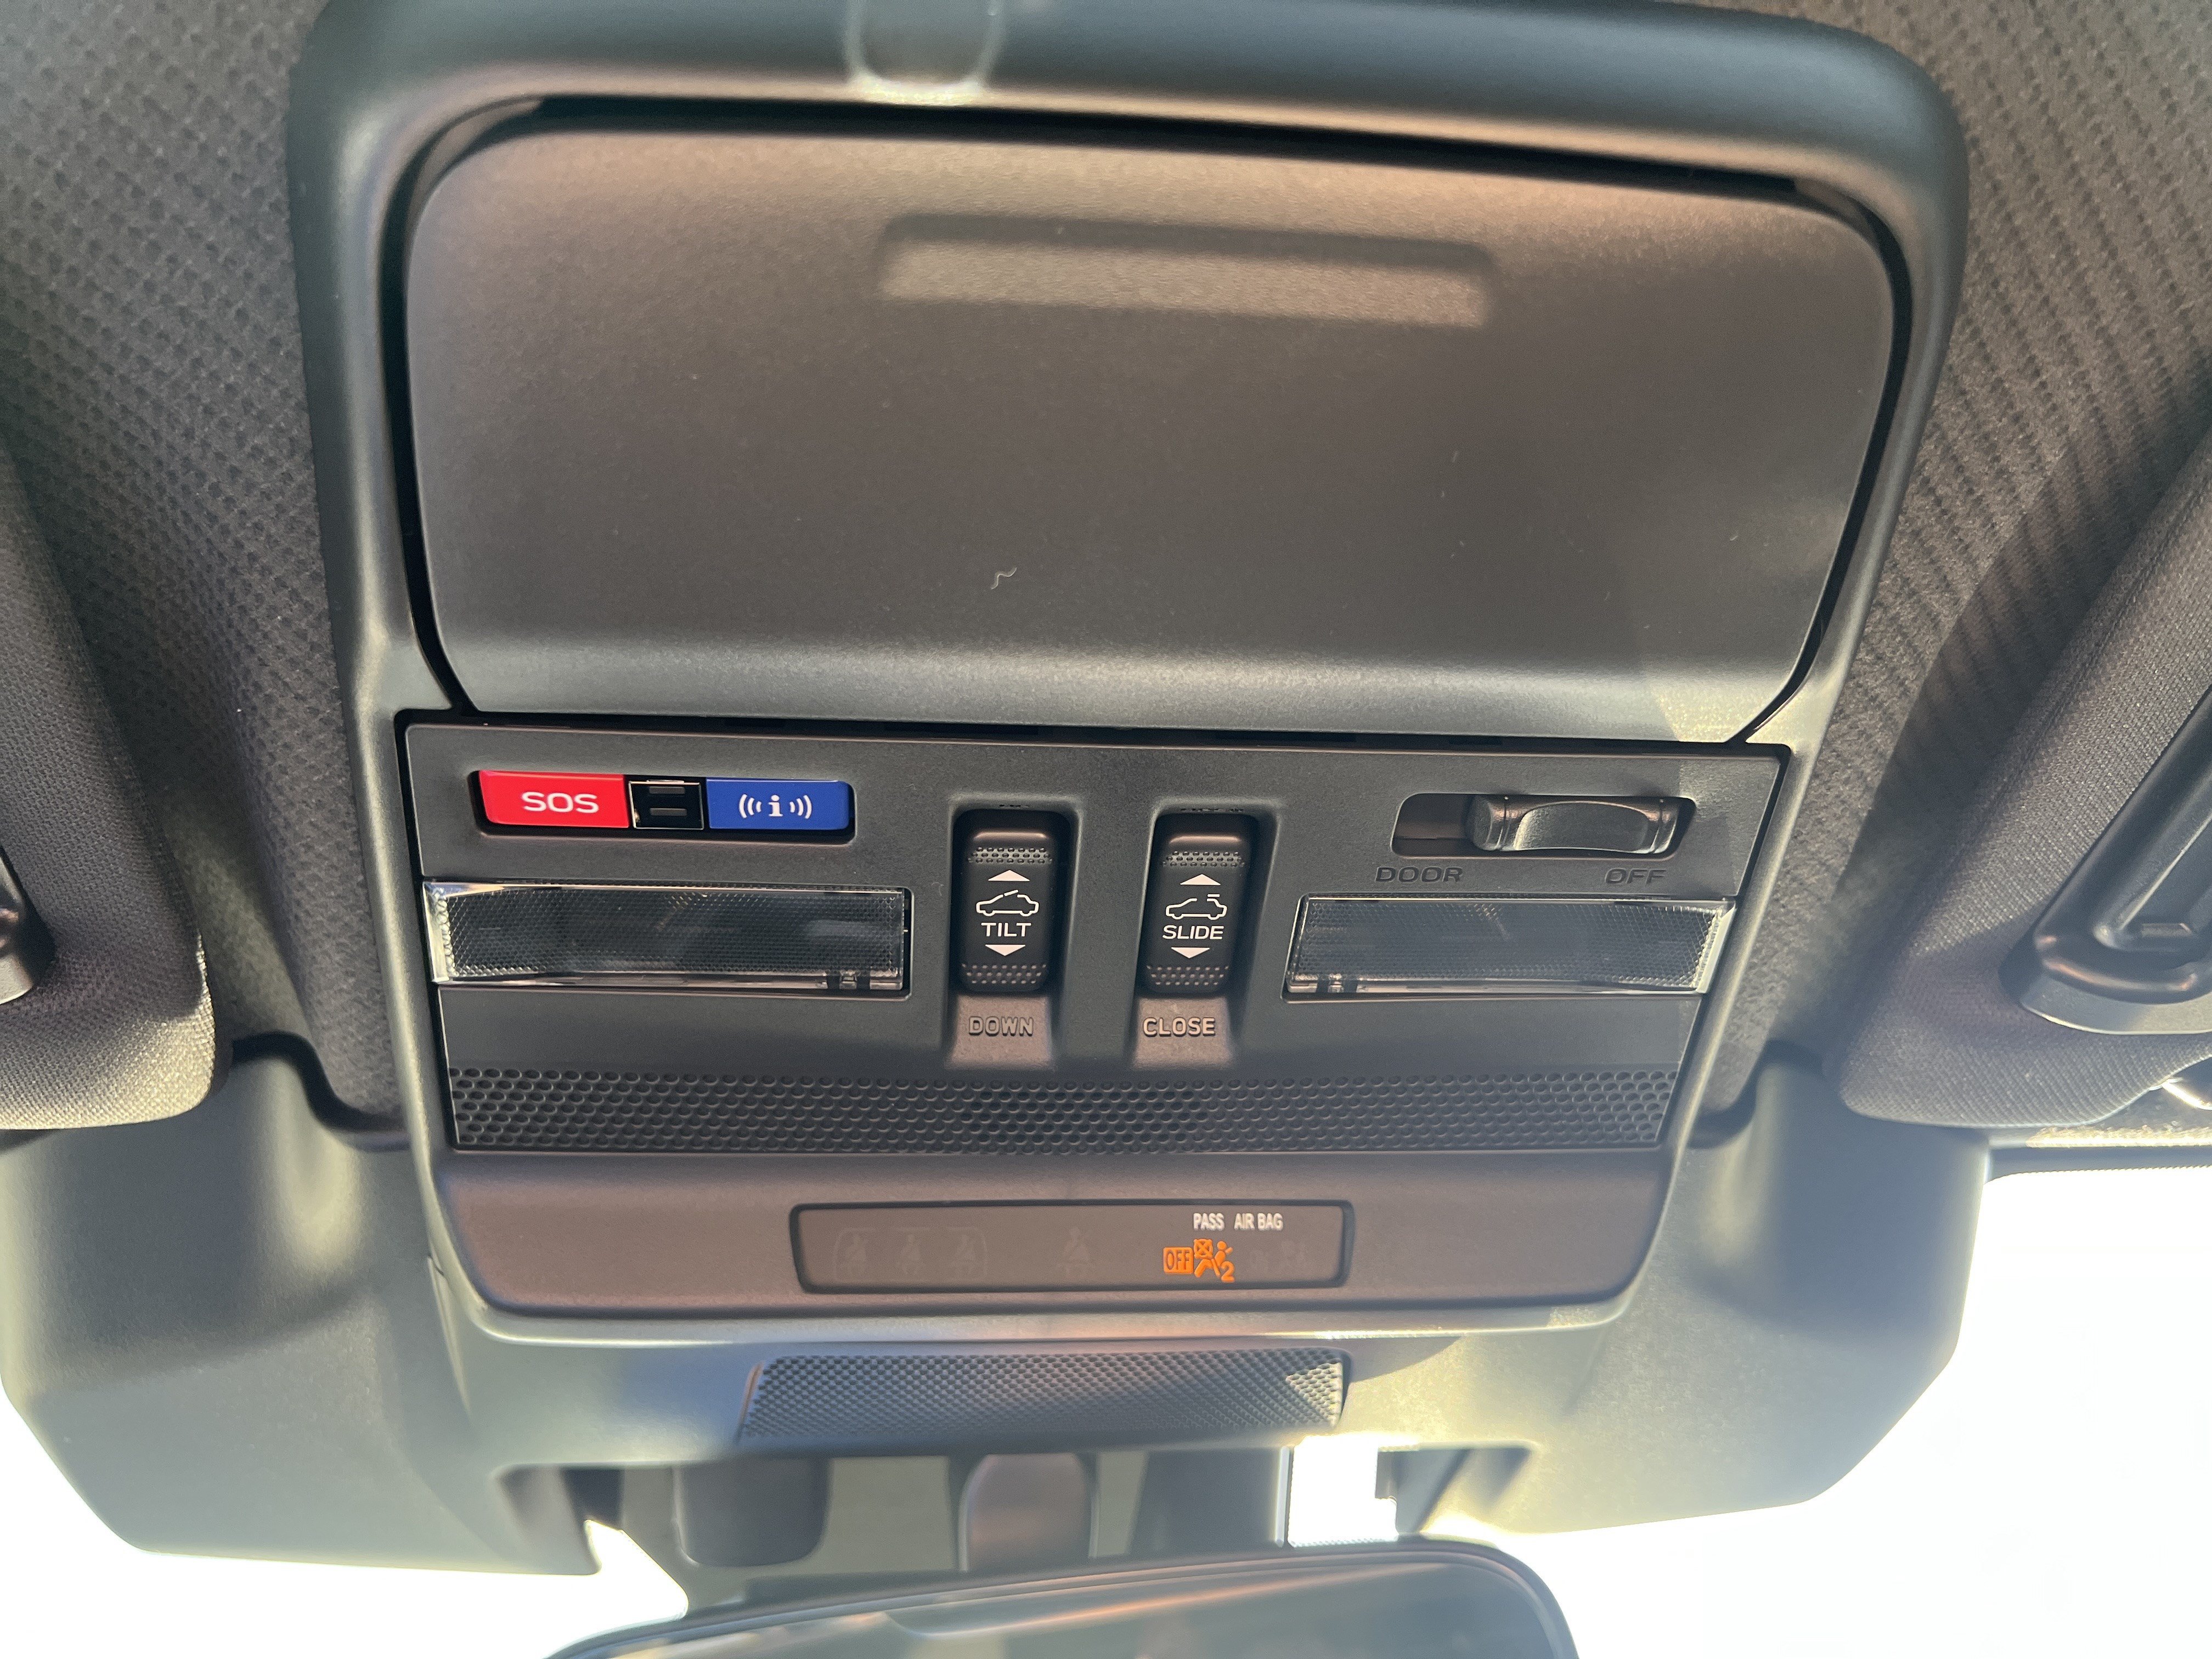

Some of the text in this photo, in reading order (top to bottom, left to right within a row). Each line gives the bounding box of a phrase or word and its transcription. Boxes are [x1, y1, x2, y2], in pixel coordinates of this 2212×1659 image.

[522, 792, 599, 814] SOS
[1375, 867, 1463, 882] DOOR
[1605, 868, 1666, 884] OFF
[981, 922, 1031, 937] TILT
[1163, 926, 1224, 940] SLIDE
[969, 1017, 1034, 1037] DOWN
[1143, 1018, 1215, 1036] CLOSE
[1193, 1212, 1284, 1231] PASS AIR BAG
[1166, 1249, 1190, 1271] OFF
[1221, 1261, 1235, 1282] 2
